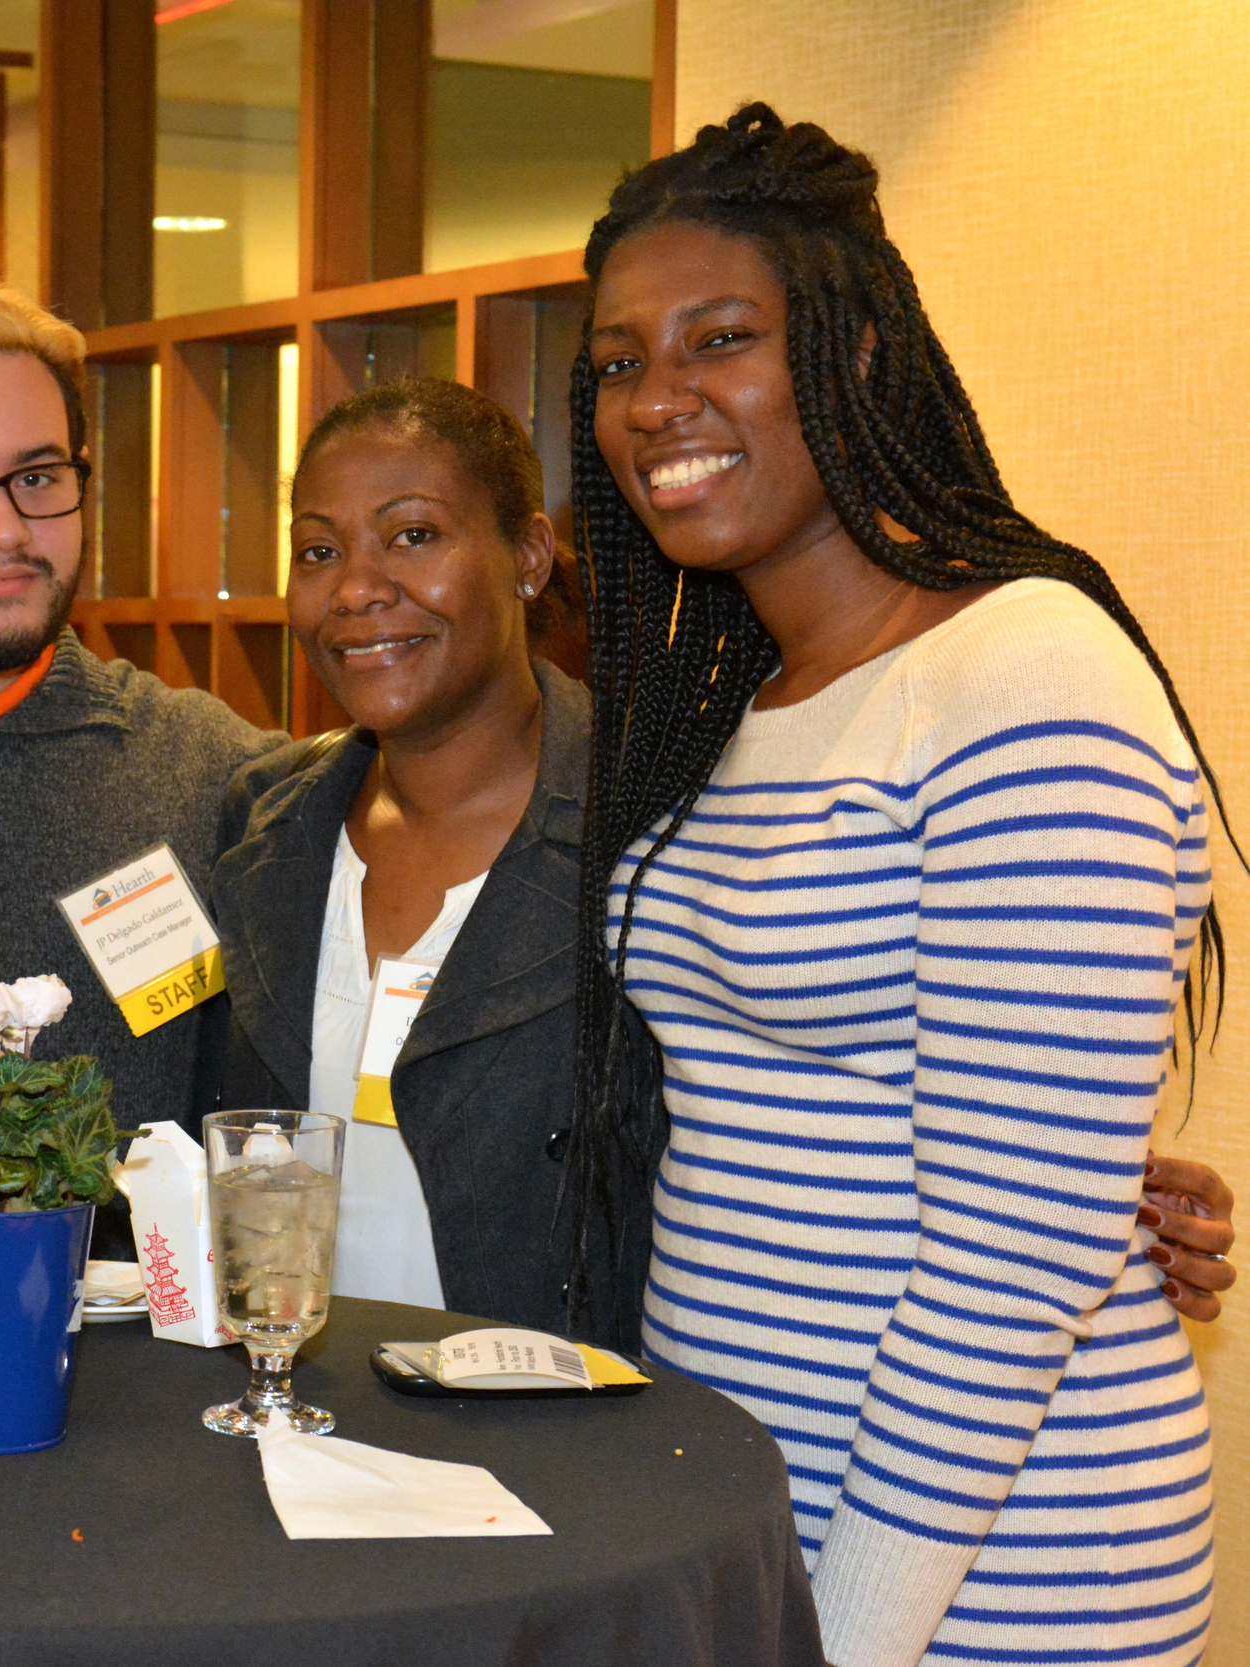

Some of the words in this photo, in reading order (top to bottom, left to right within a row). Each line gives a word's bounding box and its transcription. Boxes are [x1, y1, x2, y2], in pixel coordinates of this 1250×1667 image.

[112, 868, 155, 897] Hearth
[96, 937, 106, 950] JP
[106, 920, 143, 943] Delgado
[142, 898, 184, 924] Galdamez
[106, 951, 126, 965] Senior
[126, 937, 152, 955] Outreach
[152, 930, 168, 941] Case
[167, 915, 192, 934] Manager
[147, 966, 209, 1015] STAFF
